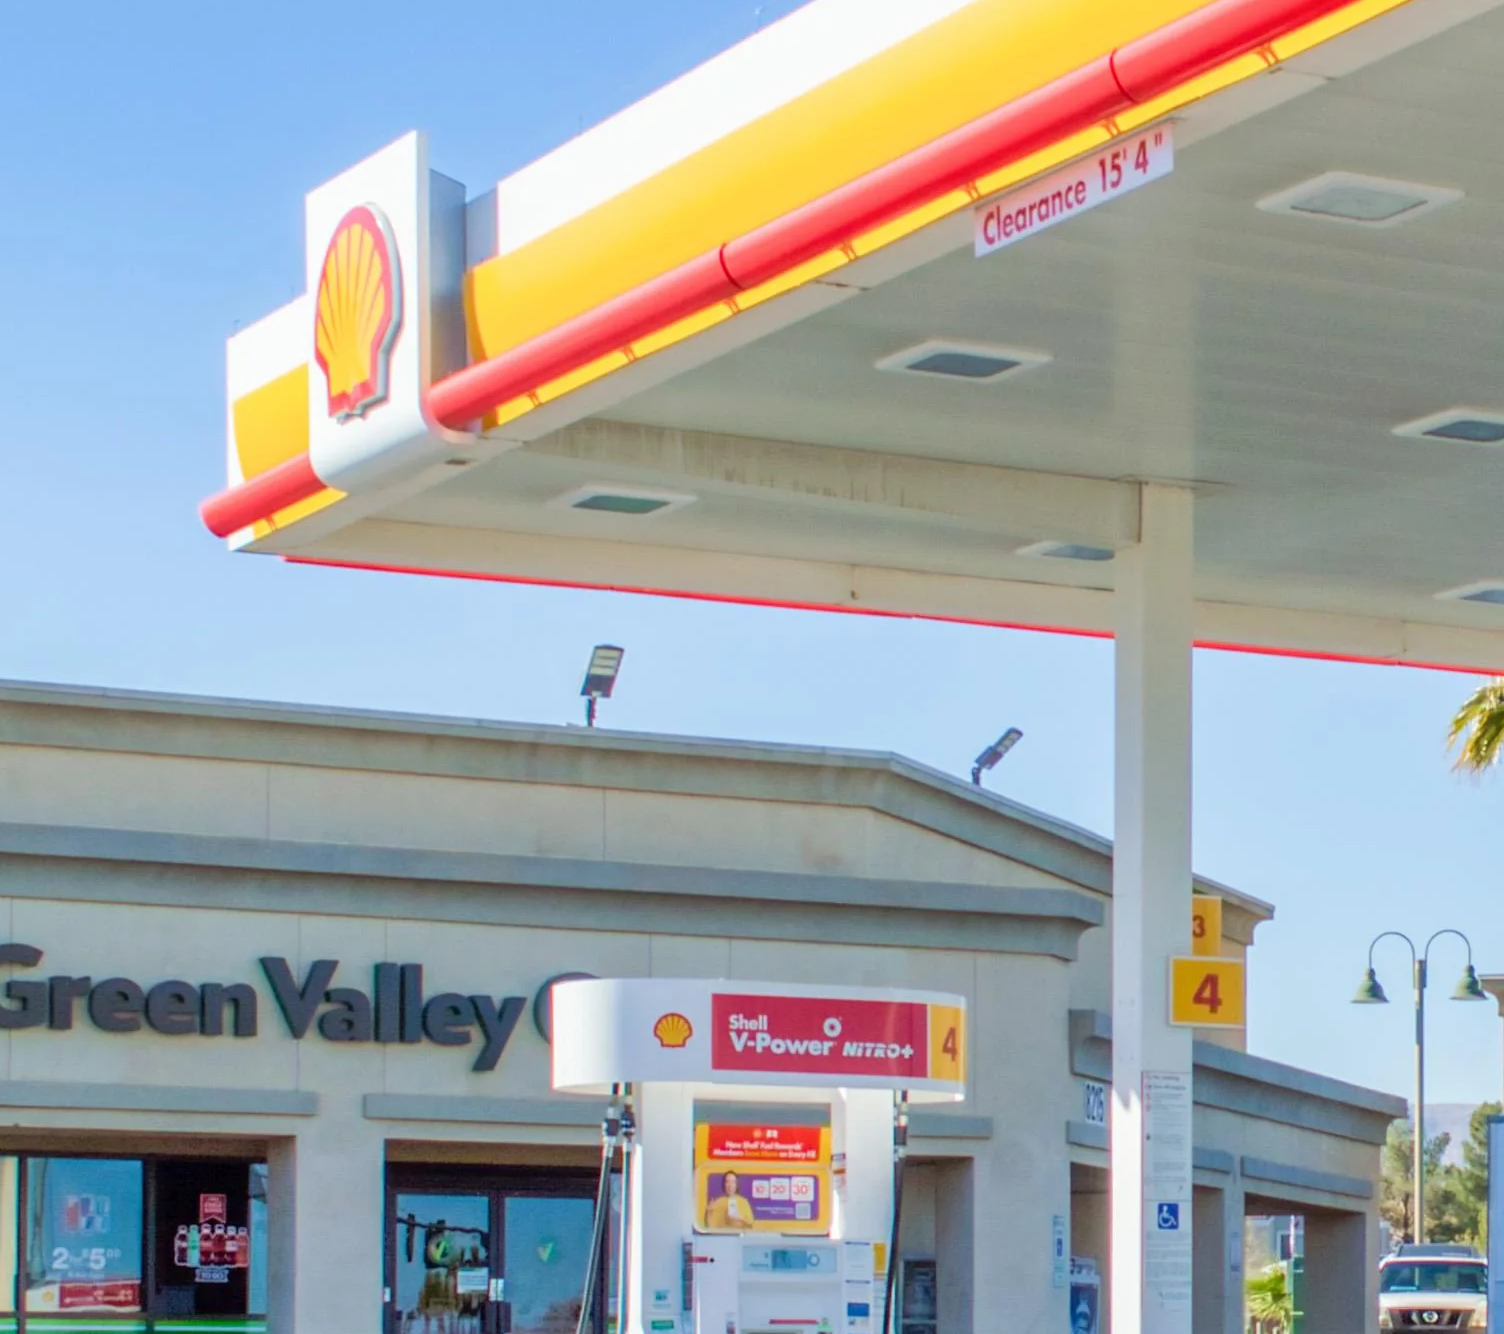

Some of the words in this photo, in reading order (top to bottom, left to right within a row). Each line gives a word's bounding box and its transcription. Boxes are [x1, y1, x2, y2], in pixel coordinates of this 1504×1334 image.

[982, 178, 1087, 246] Clearance
[1192, 915, 1205, 938] 3
[1192, 973, 1223, 1014] 4
[259, 955, 527, 1073] Valley
[728, 1013, 768, 1032] Shell
[729, 1032, 834, 1057] V-Power
[942, 1026, 957, 1062] 4
[52, 1246, 69, 1270] 2
